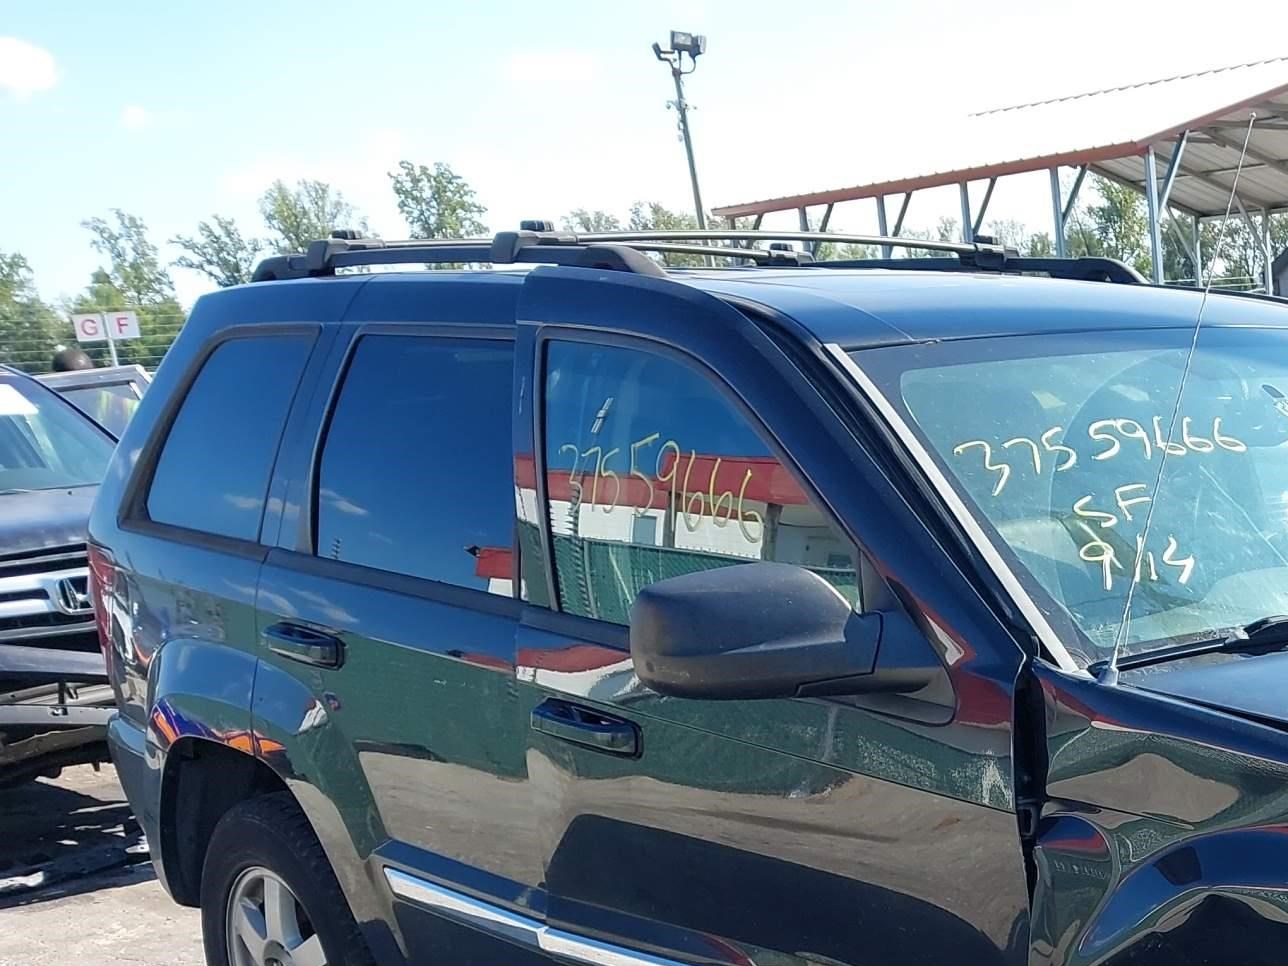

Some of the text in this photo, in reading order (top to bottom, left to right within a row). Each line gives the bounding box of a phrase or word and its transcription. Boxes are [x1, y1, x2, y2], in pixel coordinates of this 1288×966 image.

[81, 319, 99, 336] G
[116, 317, 129, 334] F
[558, 432, 764, 543] 37559666
